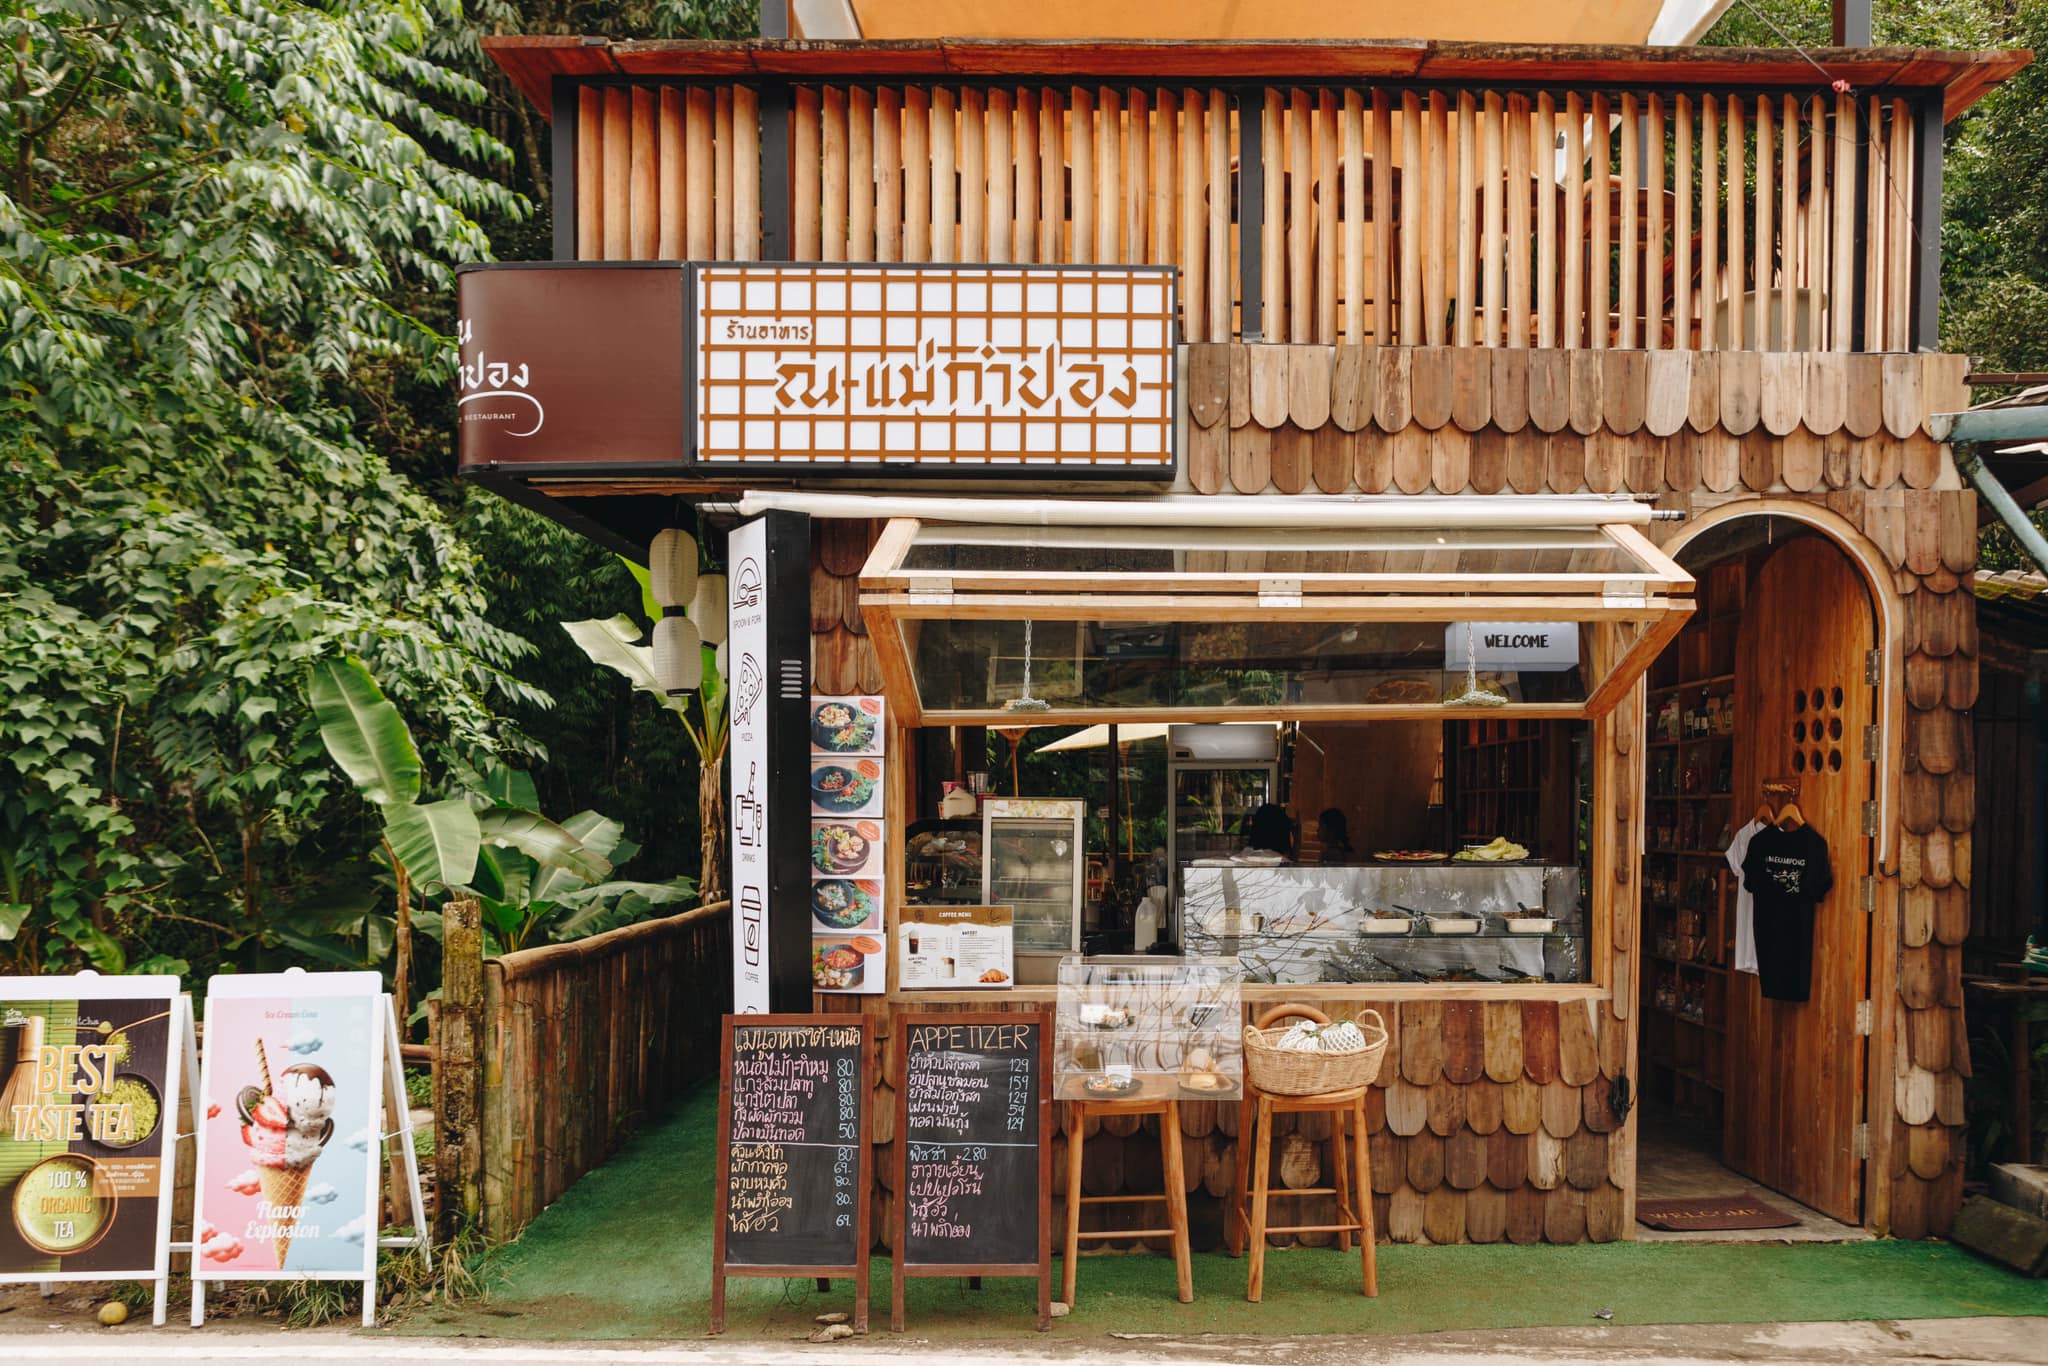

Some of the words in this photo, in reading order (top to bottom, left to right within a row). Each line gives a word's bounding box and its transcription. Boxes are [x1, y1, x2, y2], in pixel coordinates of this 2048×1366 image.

[726, 319, 809, 340] ร้านอาหาร
[1484, 634, 1550, 648] WELCOME
[909, 1024, 1031, 1052] APPETIZER
[36, 1044, 124, 1095] BEST
[1009, 1058, 1029, 1073] 129
[1008, 1075, 1029, 1090] 159
[1008, 1091, 1027, 1105] 129
[1007, 1104, 1025, 1116] 59
[12, 1104, 85, 1142] TASTE
[89, 1104, 134, 1142] TEA
[1006, 1116, 1025, 1132] 129
[961, 1147, 987, 1161] 280
[48, 1171, 72, 1189] 100
[75, 1170, 87, 1188] %
[40, 1196, 92, 1215] ORGANIC
[256, 1200, 310, 1219] Flavor
[54, 1221, 75, 1239] TEA
[245, 1220, 320, 1243] Explosion
